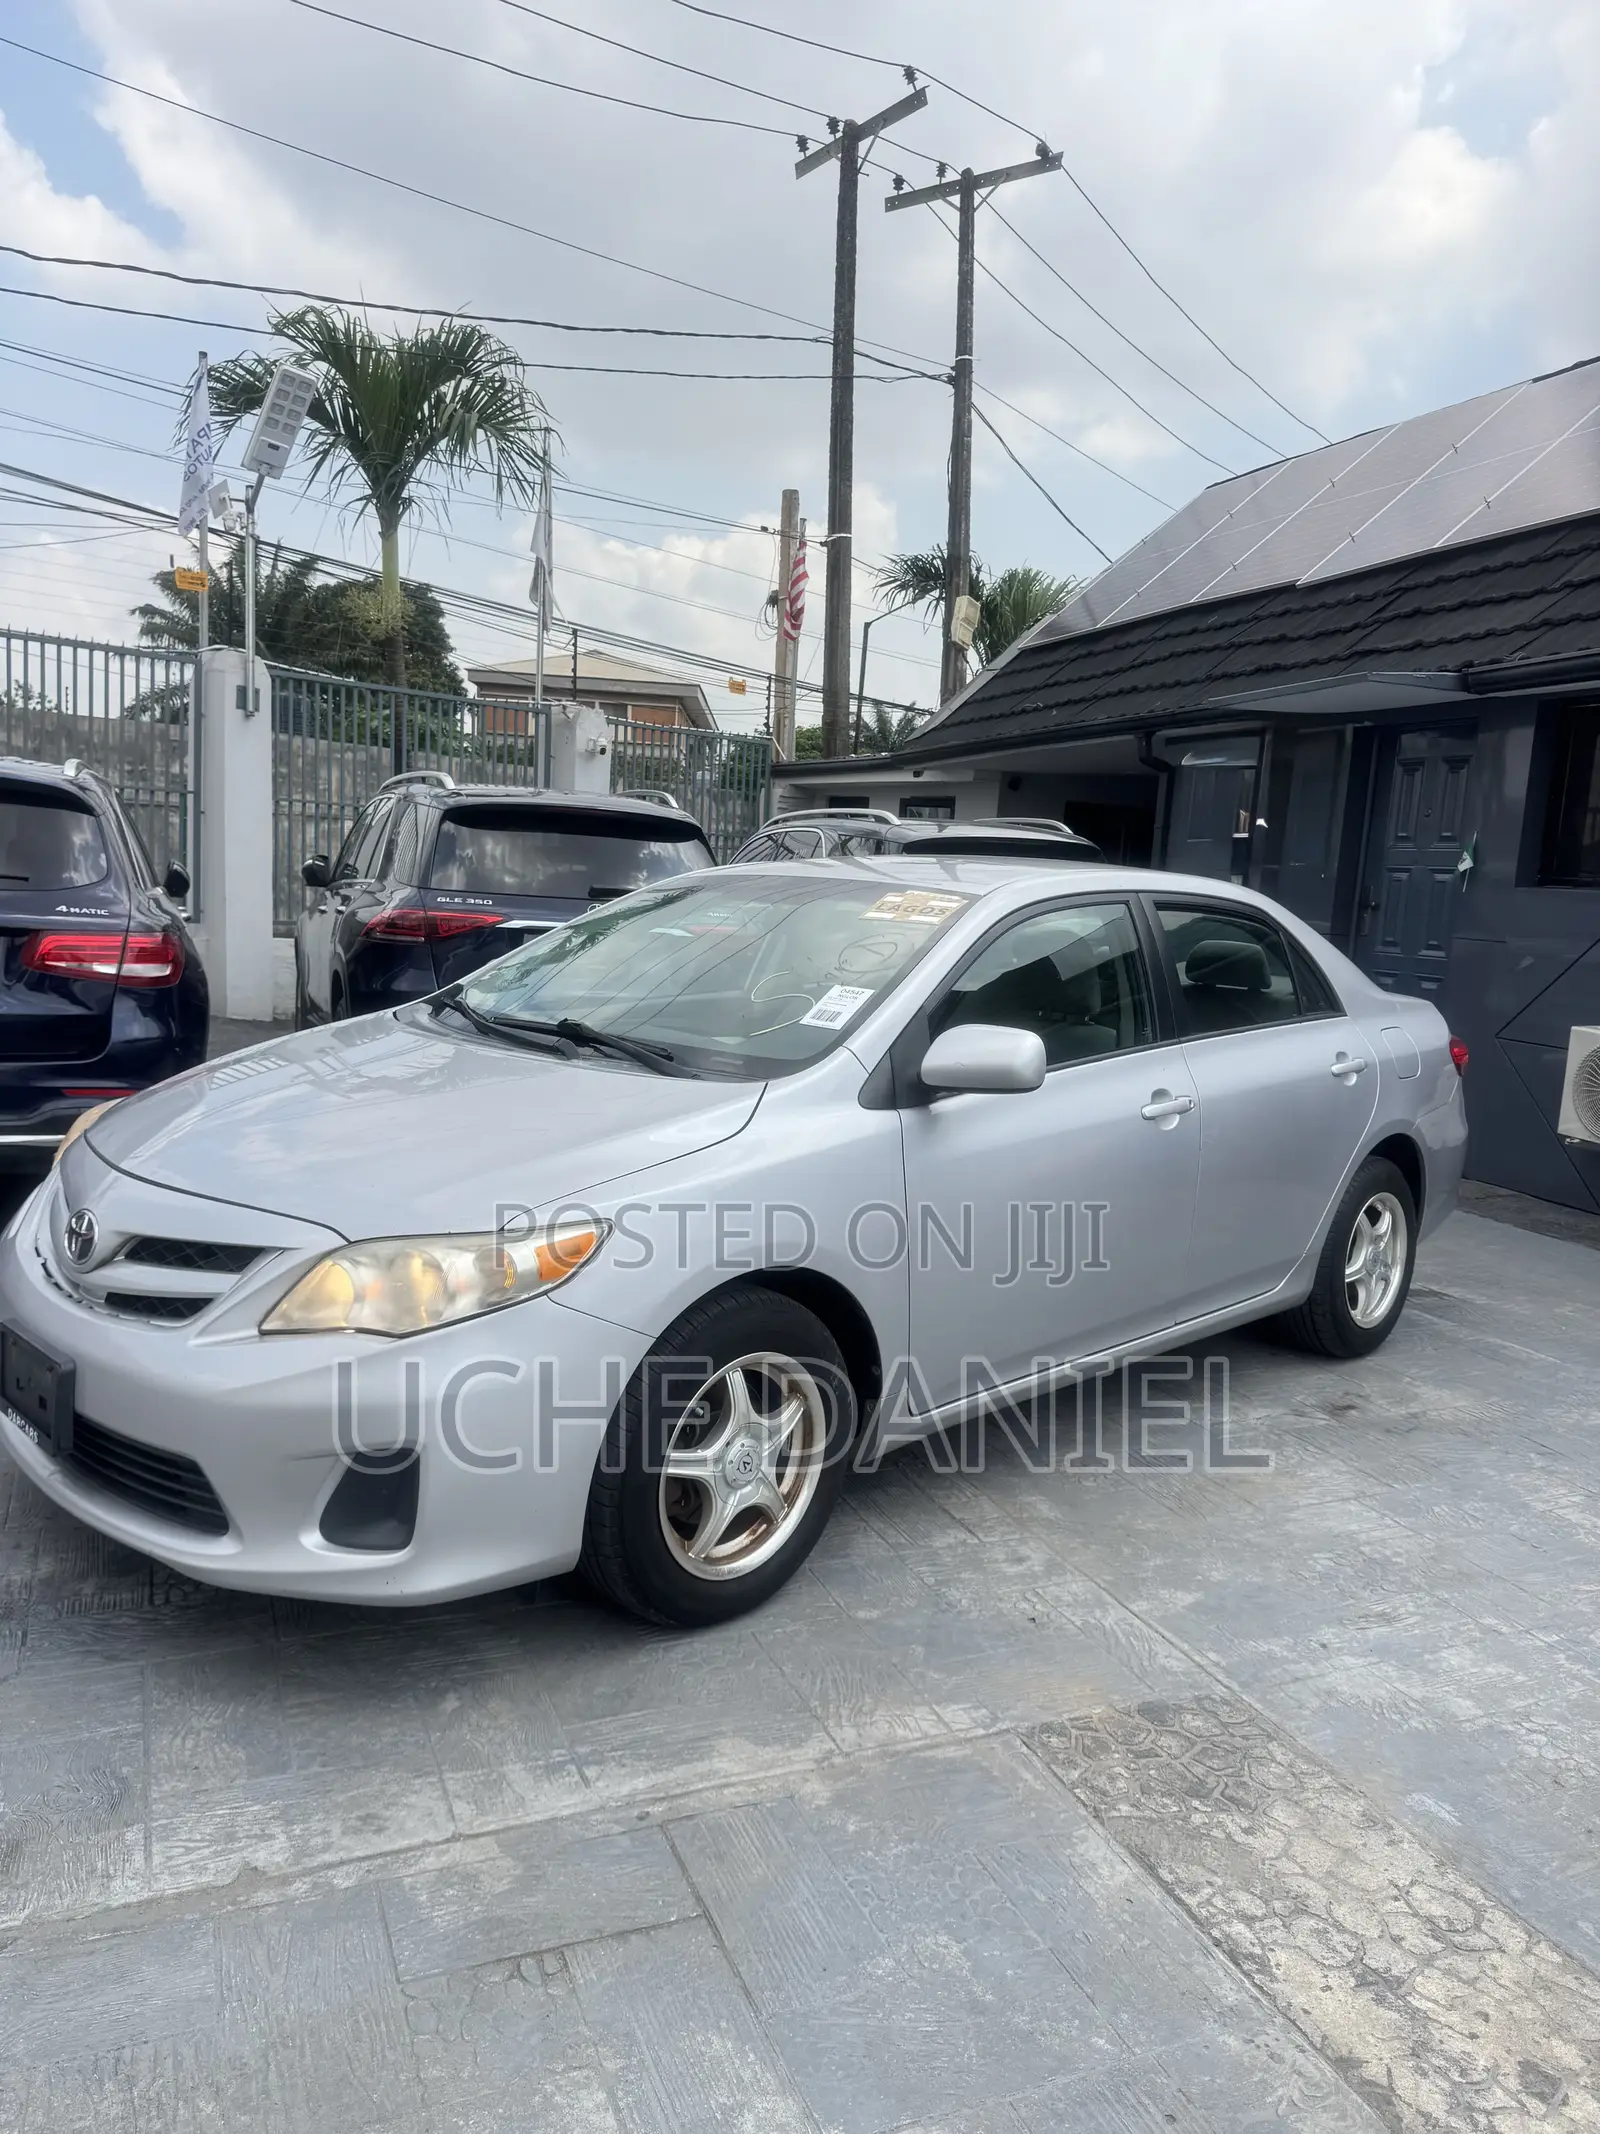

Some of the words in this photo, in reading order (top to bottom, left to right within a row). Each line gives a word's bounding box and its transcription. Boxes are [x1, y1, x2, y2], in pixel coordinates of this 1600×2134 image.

[436, 896, 463, 904] GLE
[465, 898, 493, 906] 350
[55, 905, 110, 916] 4MATIC
[874, 903, 950, 916] LAGOS
